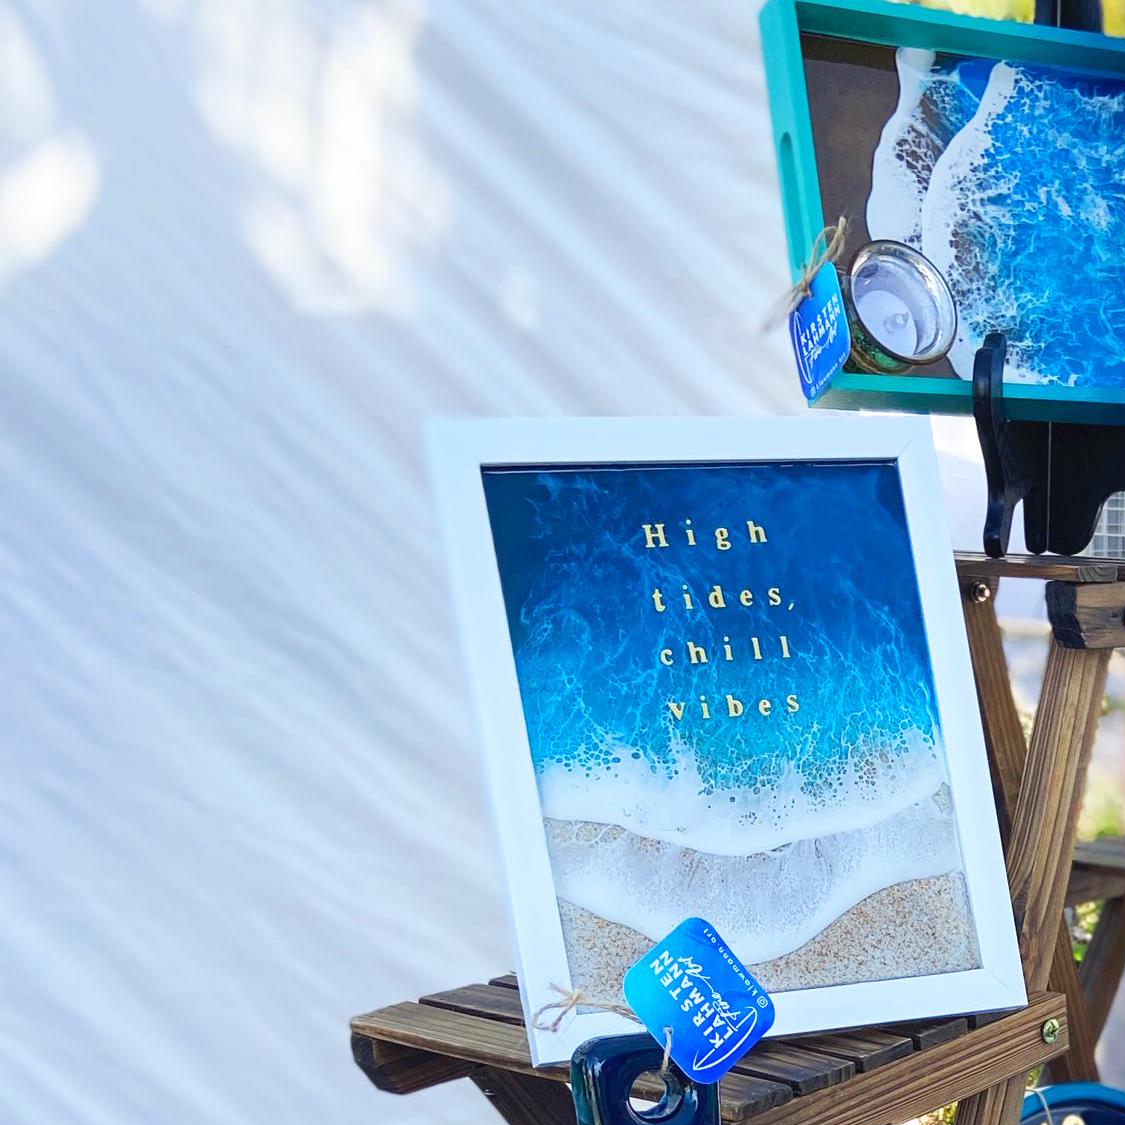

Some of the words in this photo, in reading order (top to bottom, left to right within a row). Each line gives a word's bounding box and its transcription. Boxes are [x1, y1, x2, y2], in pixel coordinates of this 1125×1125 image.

[800, 292, 838, 346] KIRSTEN
[803, 304, 841, 357] LAHMANN
[641, 519, 768, 550] High
[652, 584, 794, 612] tides,
[660, 635, 791, 666] chill
[668, 694, 800, 720] vibes
[649, 960, 725, 1049] KIRSTEN
[659, 950, 736, 1041] LAHMANN
